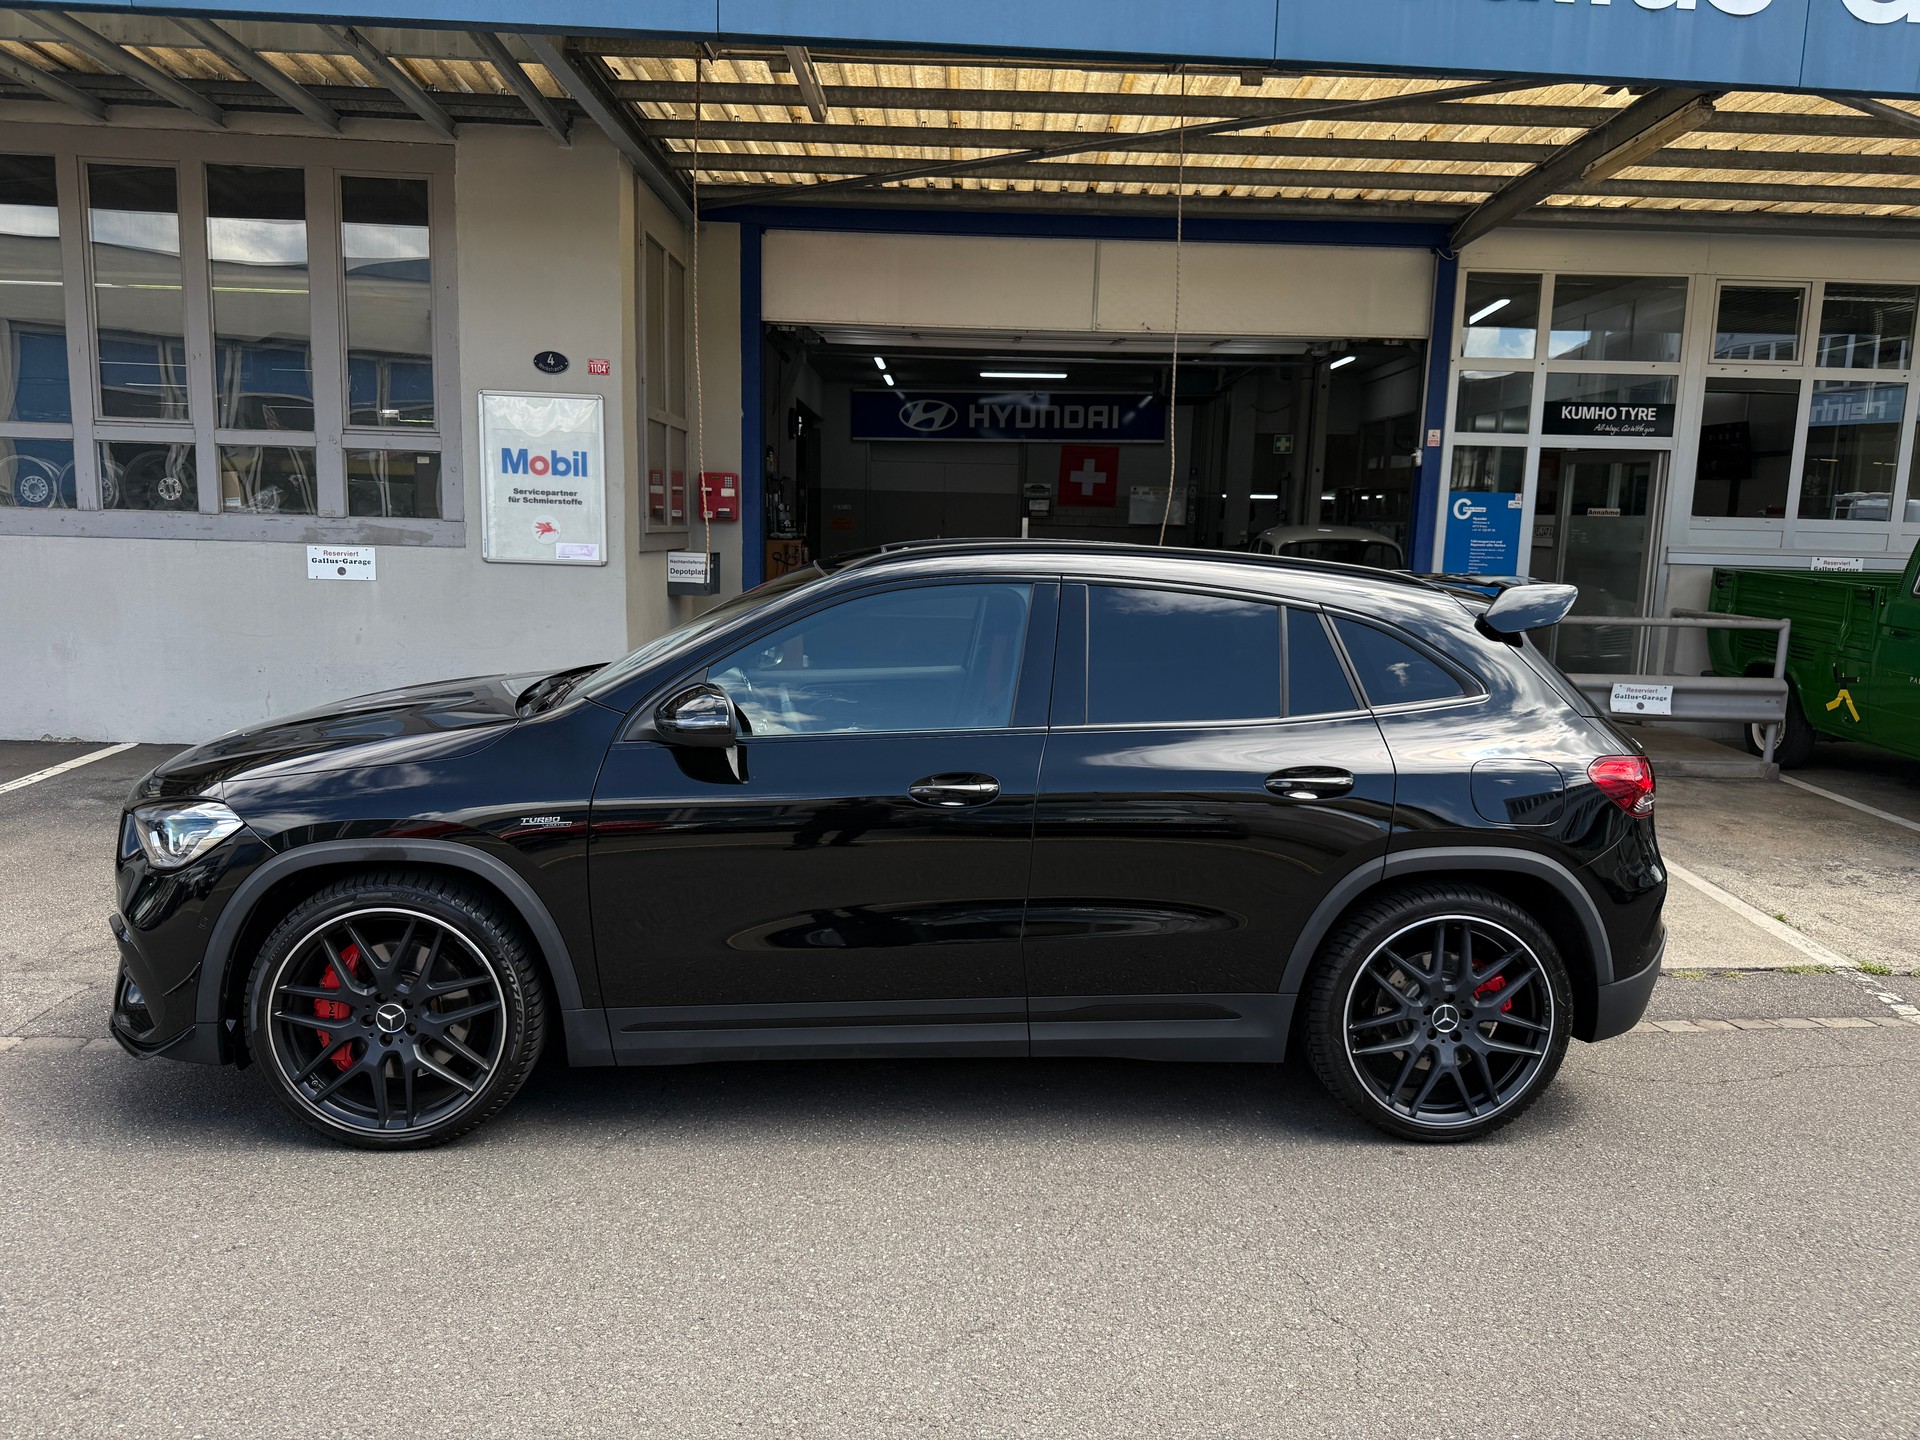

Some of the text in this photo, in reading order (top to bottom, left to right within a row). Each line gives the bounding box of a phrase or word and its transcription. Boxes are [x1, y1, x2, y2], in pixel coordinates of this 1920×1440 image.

[547, 353, 555, 366] 4
[590, 364, 607, 374] 1104
[968, 404, 1120, 430] HYUNDAI
[1561, 405, 1657, 421] KUMHO TYRE
[501, 447, 588, 477] Mobil
[512, 487, 578, 497] Servicepartner
[522, 496, 583, 506] Schmierstoffe
[311, 557, 372, 566] Gallus-Garage
[669, 558, 706, 566] Nachtanlieferun
[1626, 686, 1658, 695] Reserviert
[1614, 693, 1668, 702] Gallus-Garage
[520, 816, 561, 825] TURBO
